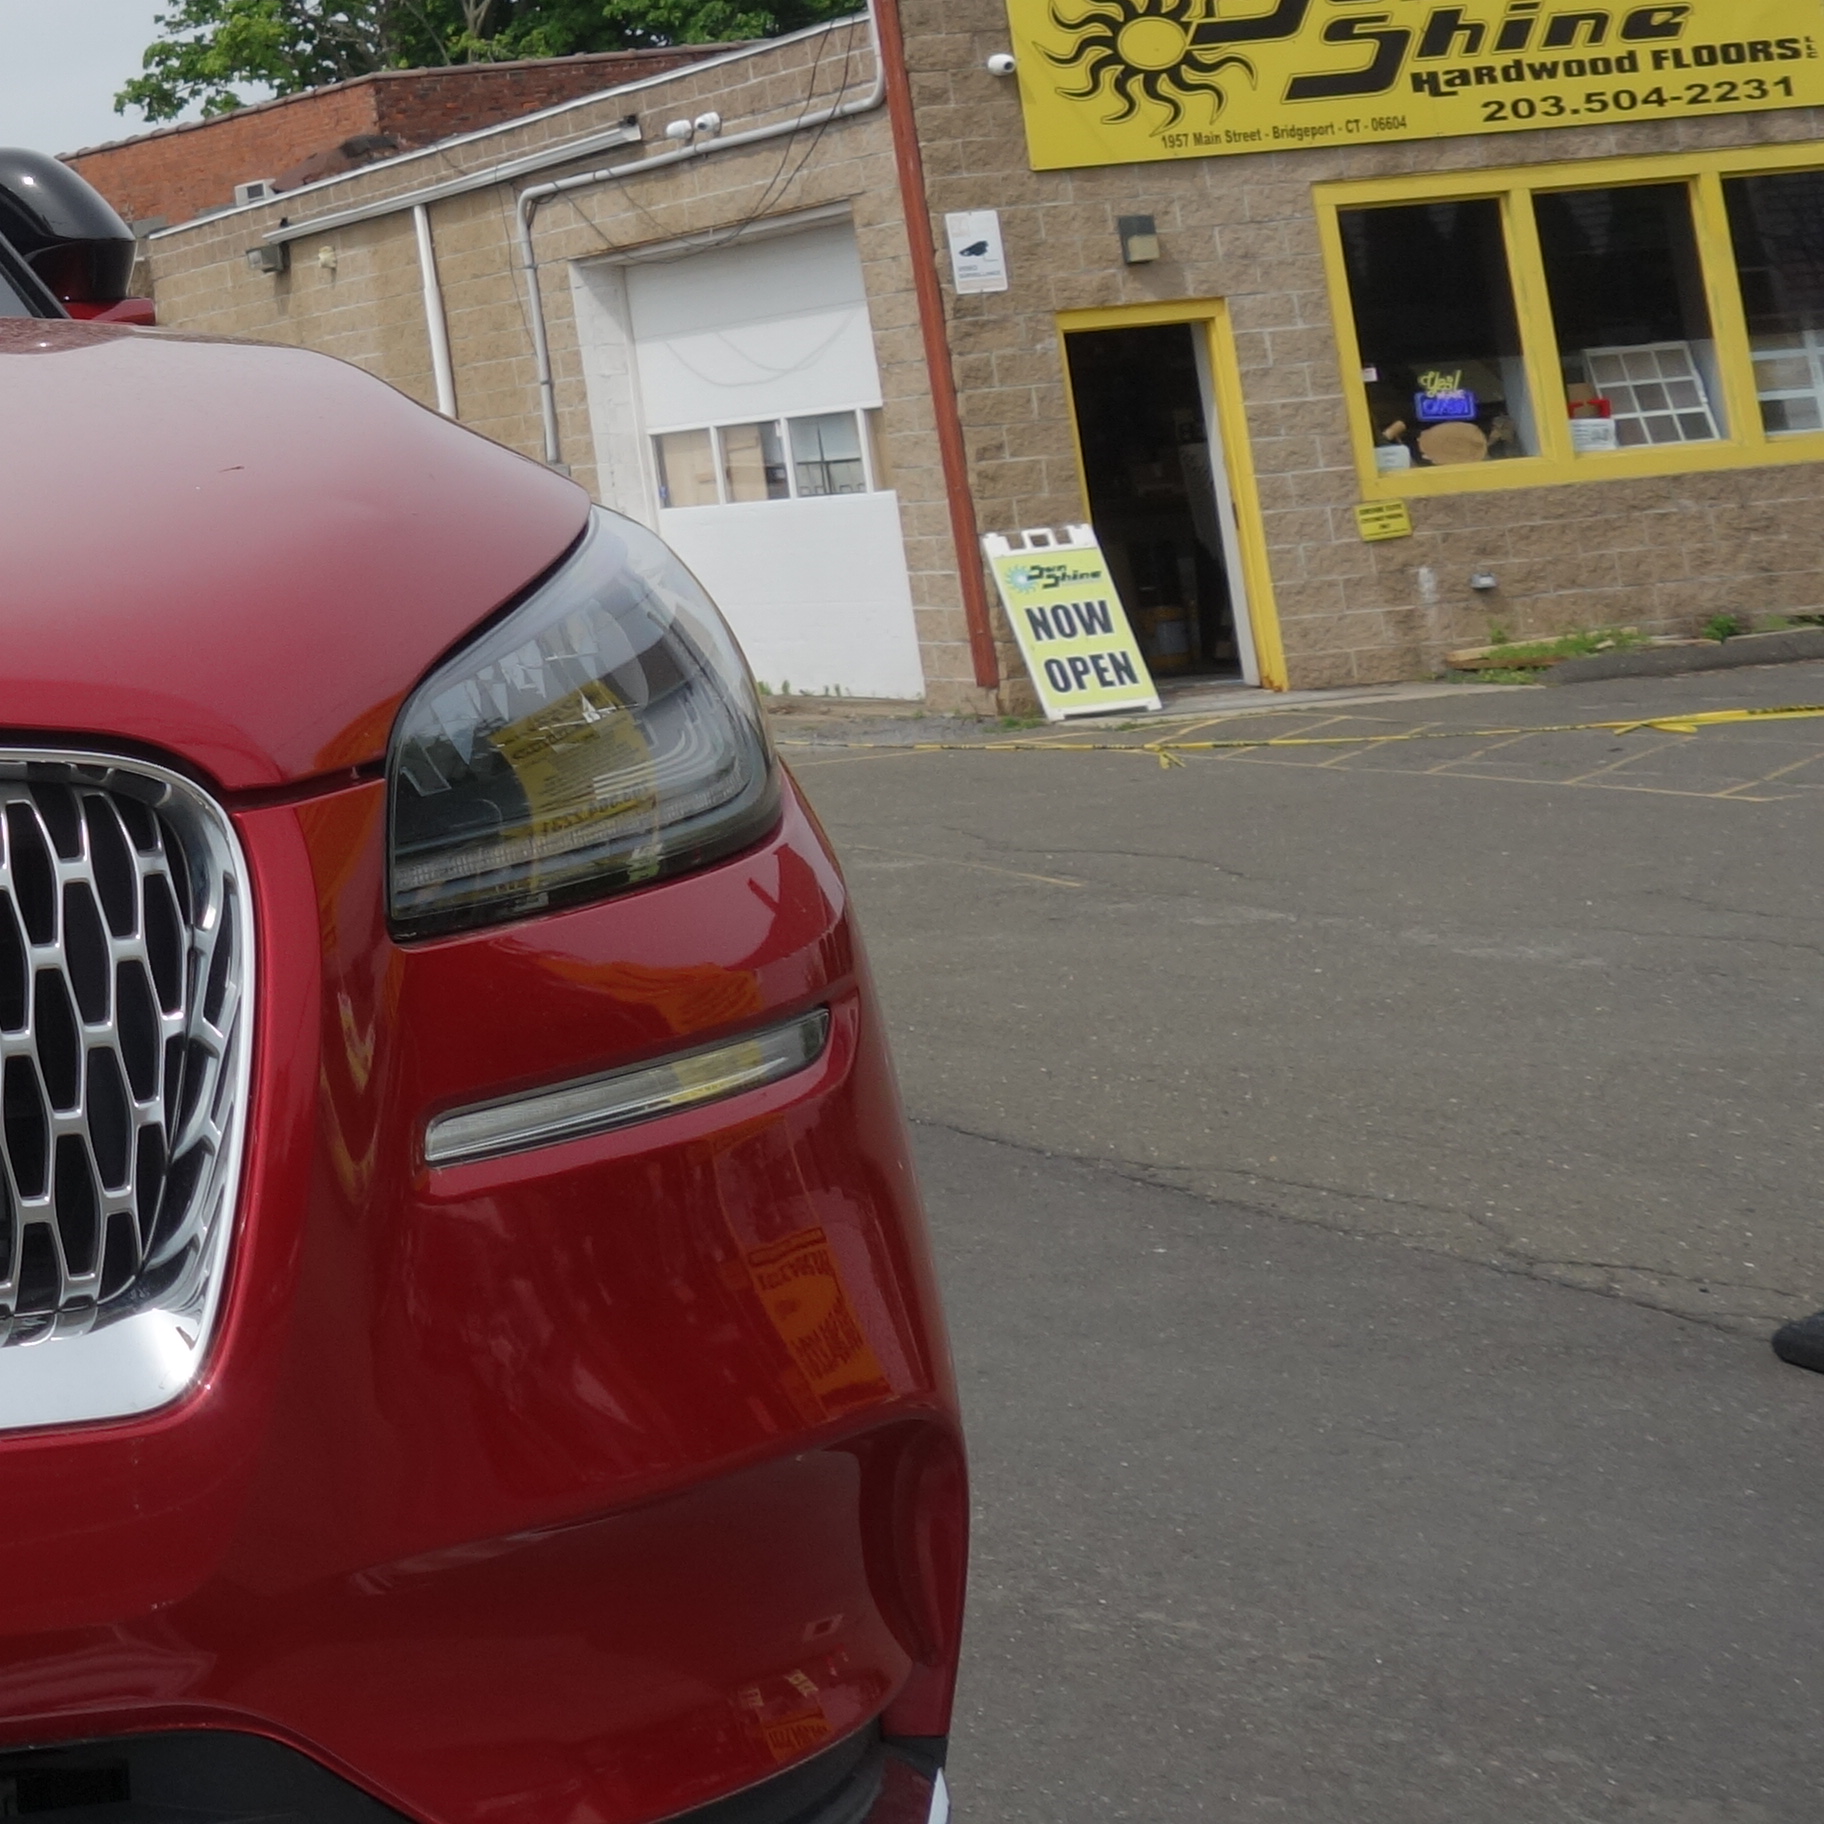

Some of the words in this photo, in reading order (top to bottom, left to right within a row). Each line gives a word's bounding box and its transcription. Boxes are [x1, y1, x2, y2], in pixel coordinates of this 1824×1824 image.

[1281, 0, 1693, 105] Shine
[1650, 37, 1803, 71] FLOORS
[1482, 75, 1794, 122] 203.504-2231
[1161, 133, 1189, 149] 1957
[1193, 129, 1222, 146] Main
[1225, 126, 1262, 143] Street
[1272, 122, 1335, 143] Bridgeport
[1345, 119, 1361, 133] CT
[1371, 115, 1408, 132] 06604
[1024, 599, 1115, 642] NOW
[1043, 650, 1140, 694] OPEN
